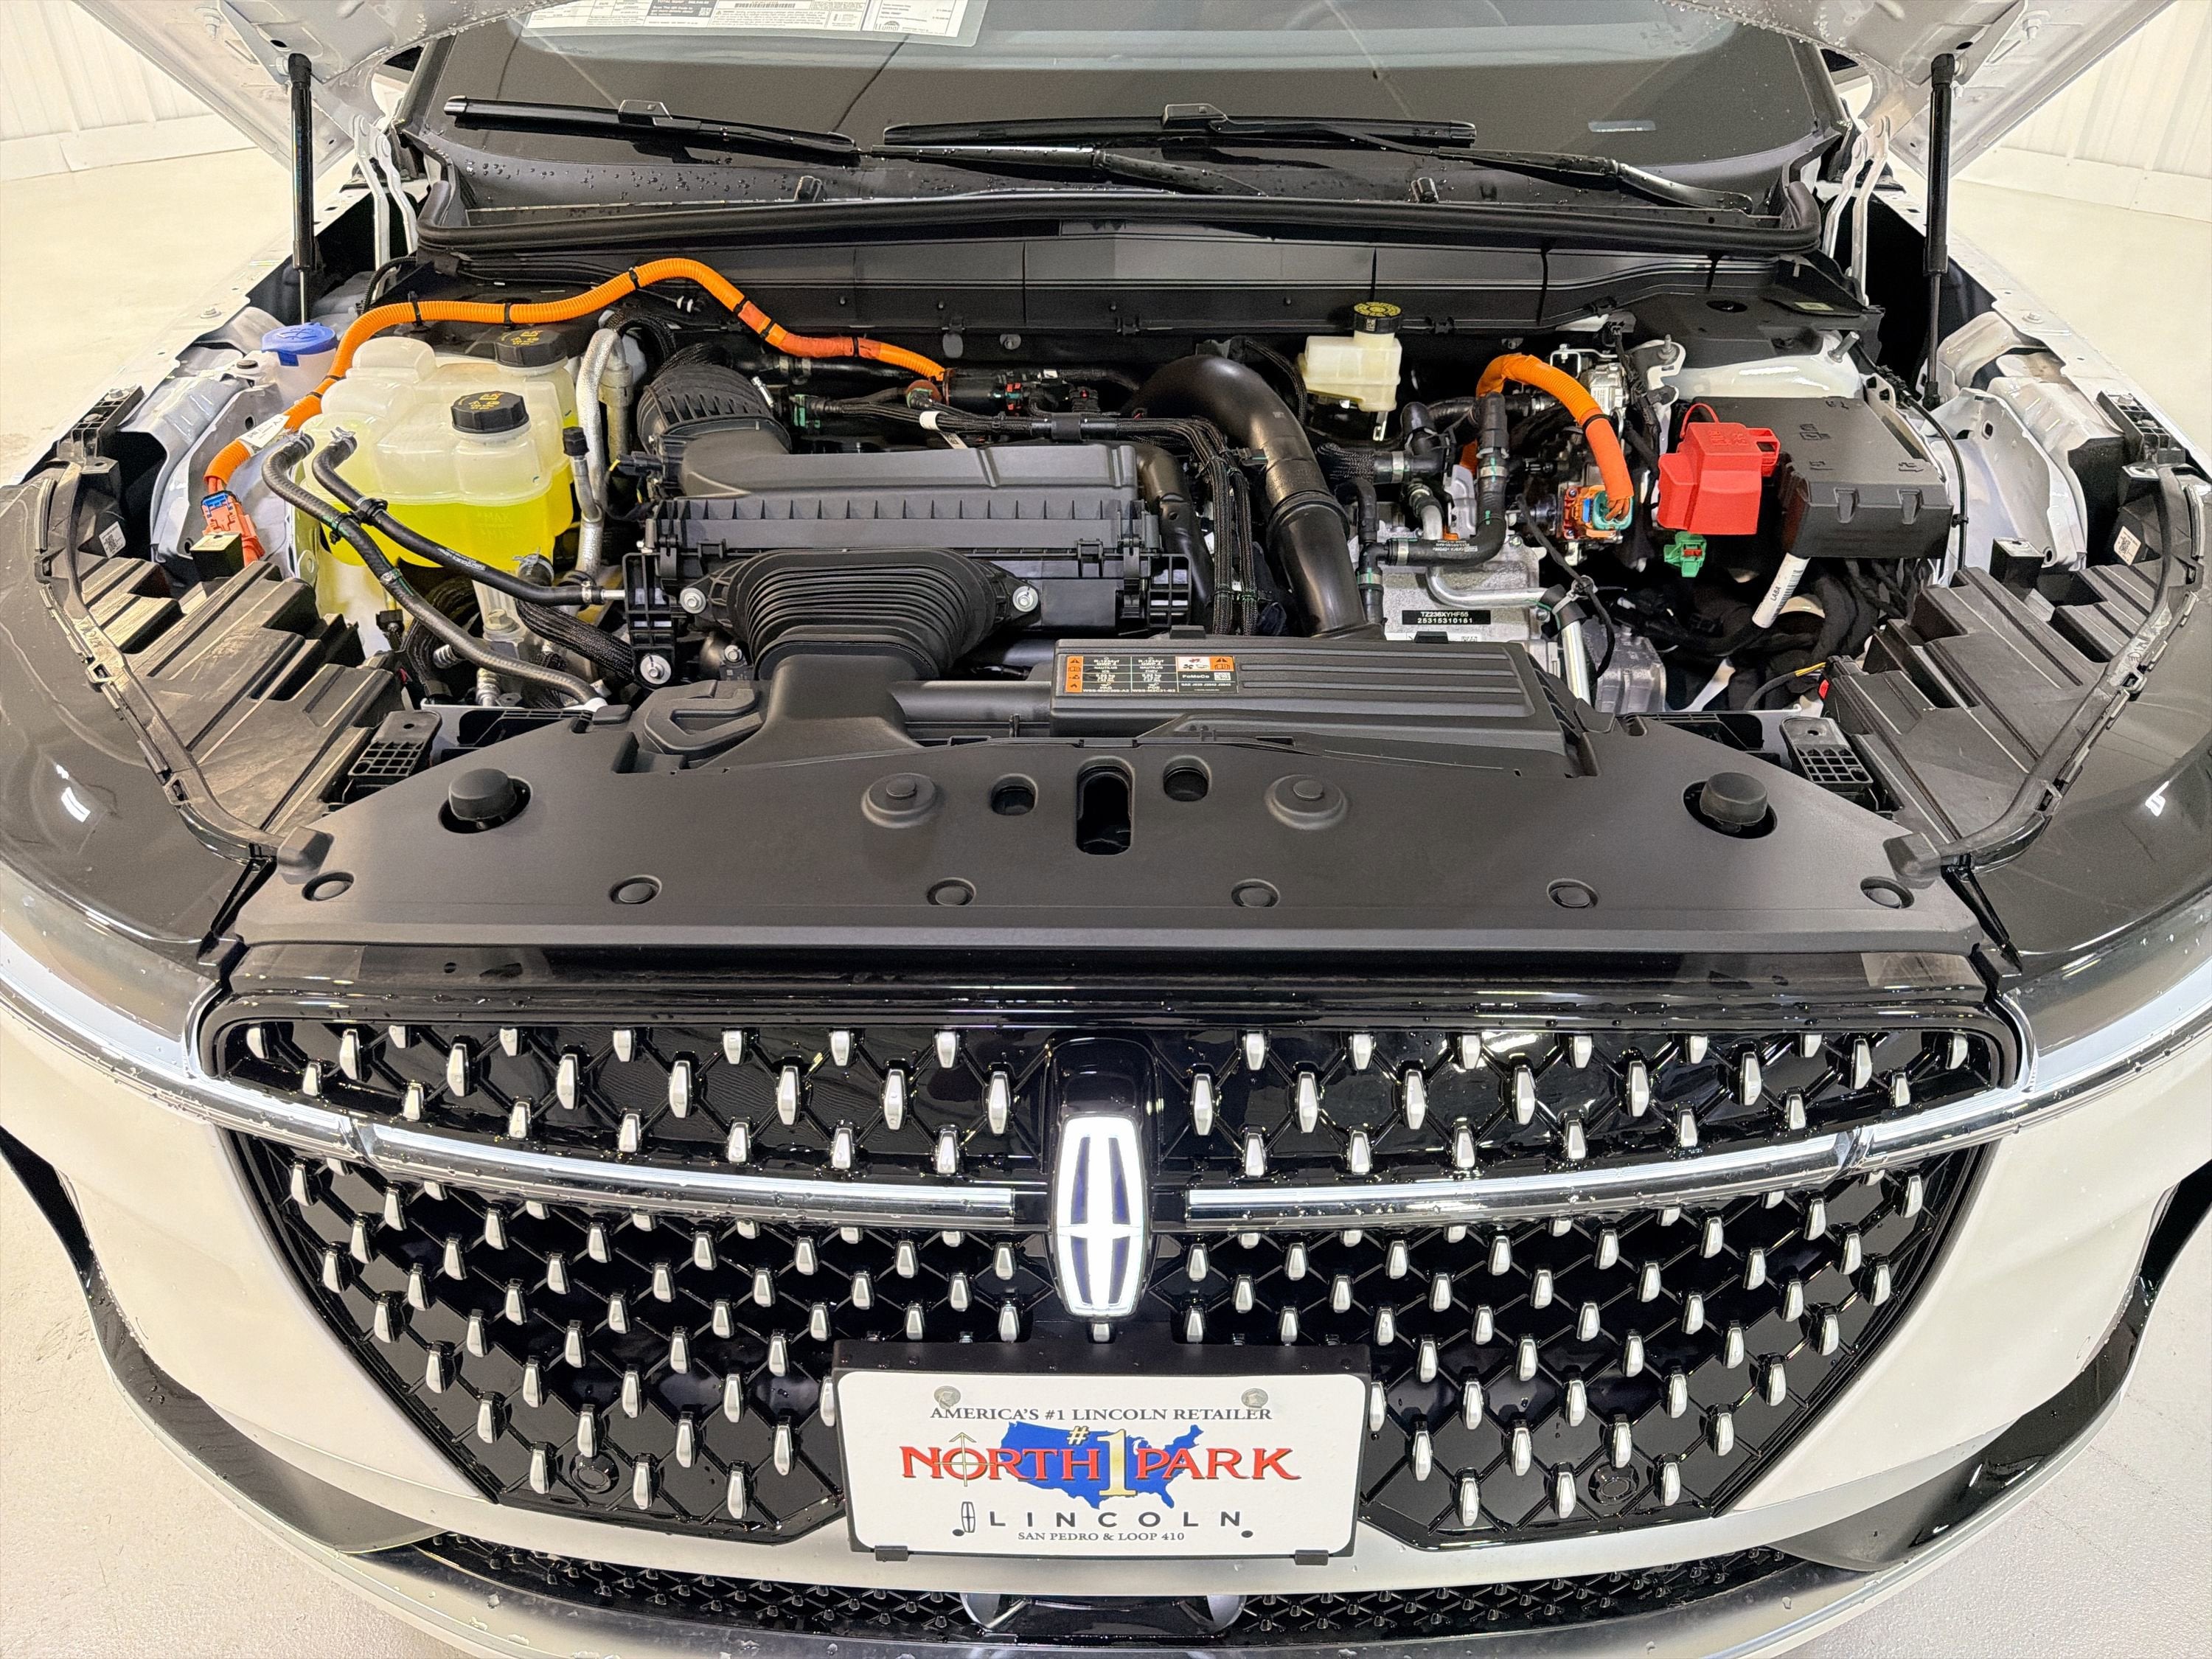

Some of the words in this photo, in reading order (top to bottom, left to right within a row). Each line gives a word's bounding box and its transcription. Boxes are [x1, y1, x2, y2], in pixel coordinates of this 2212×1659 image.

[1770, 586, 1781, 602] LABA
[931, 1407, 1039, 1421] AMERICA'S
[1044, 1408, 1064, 1421] #1
[1073, 1408, 1166, 1421] LINCOLN
[1173, 1408, 1273, 1421] RETAILER
[899, 1445, 1102, 1481] NORTH
[1135, 1447, 1302, 1481] PARK
[990, 1511, 1241, 1528] LINCOLN
[1018, 1531, 1046, 1541] SAN
[1050, 1532, 1099, 1542] PEDRO
[1102, 1532, 1115, 1541] &
[1118, 1532, 1158, 1541] LOOP
[1161, 1532, 1185, 1541] 410
